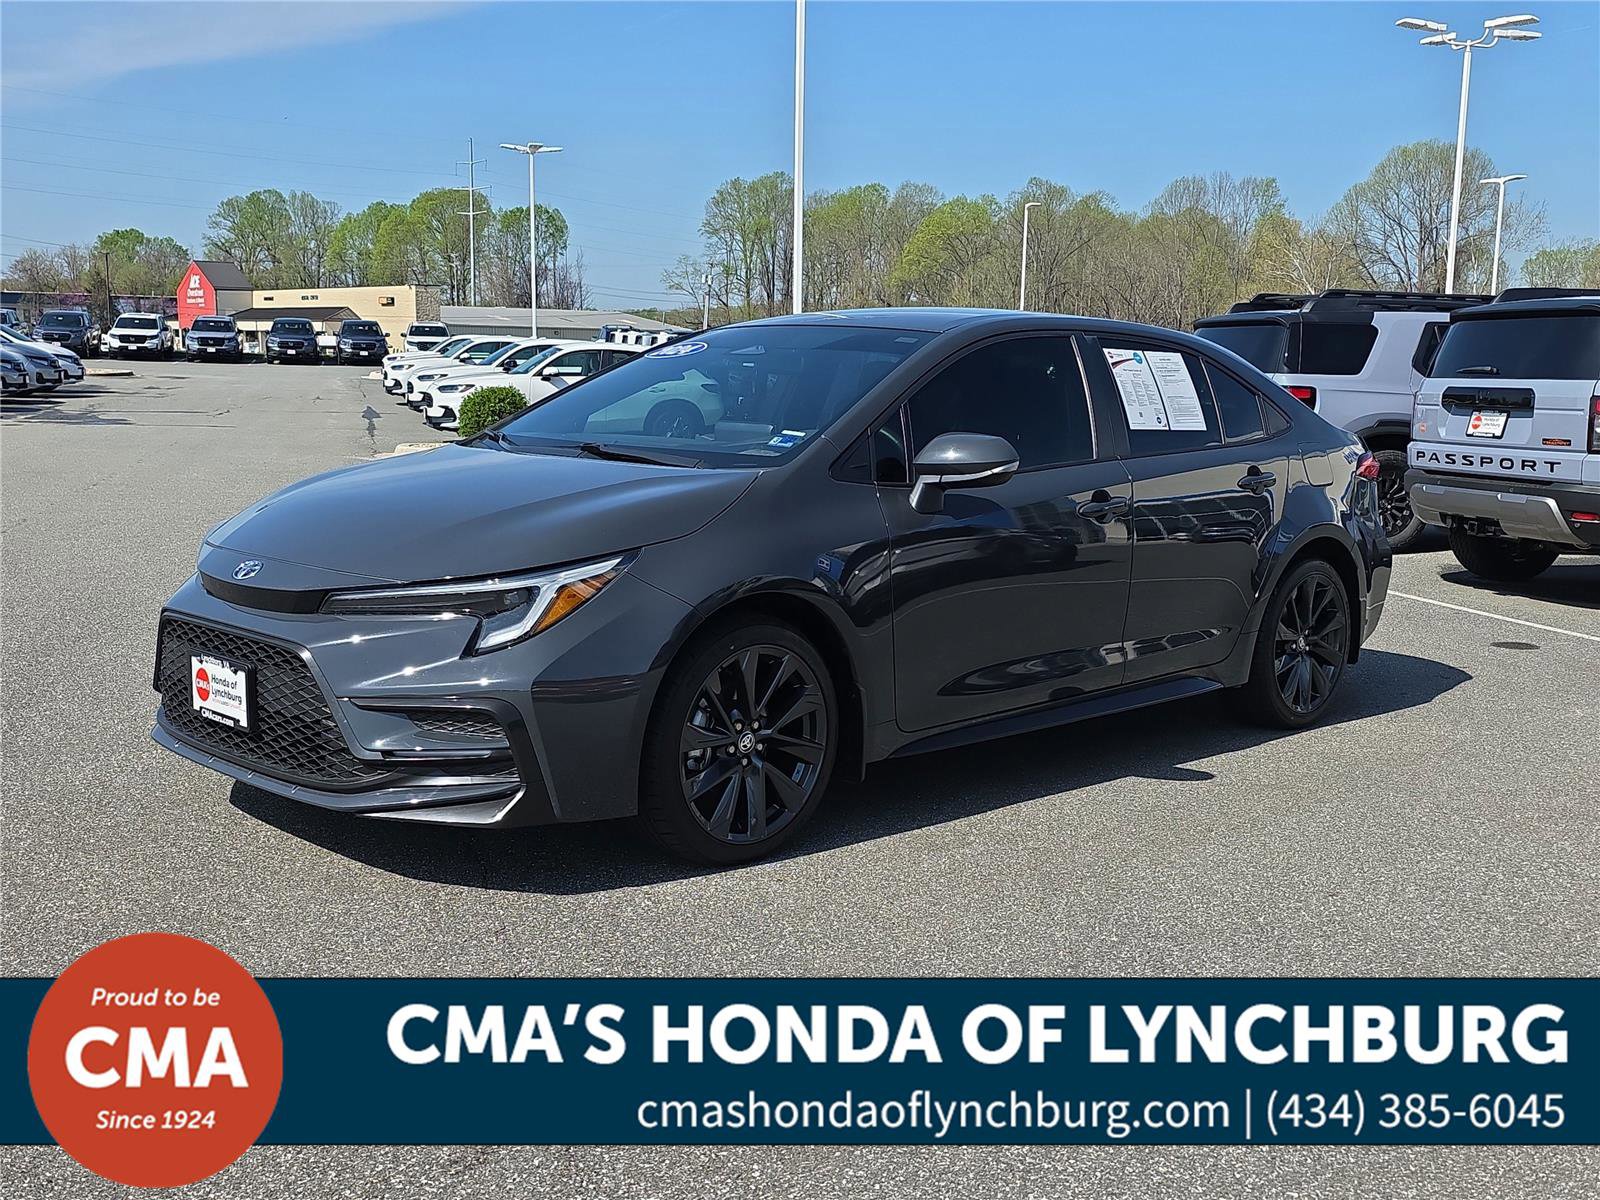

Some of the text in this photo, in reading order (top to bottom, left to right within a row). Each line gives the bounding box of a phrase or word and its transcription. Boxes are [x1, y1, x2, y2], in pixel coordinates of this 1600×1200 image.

[1416, 450, 1562, 473] PASSPORT
[211, 673, 238, 690] Honda of
[211, 684, 243, 706] Lynchburg
